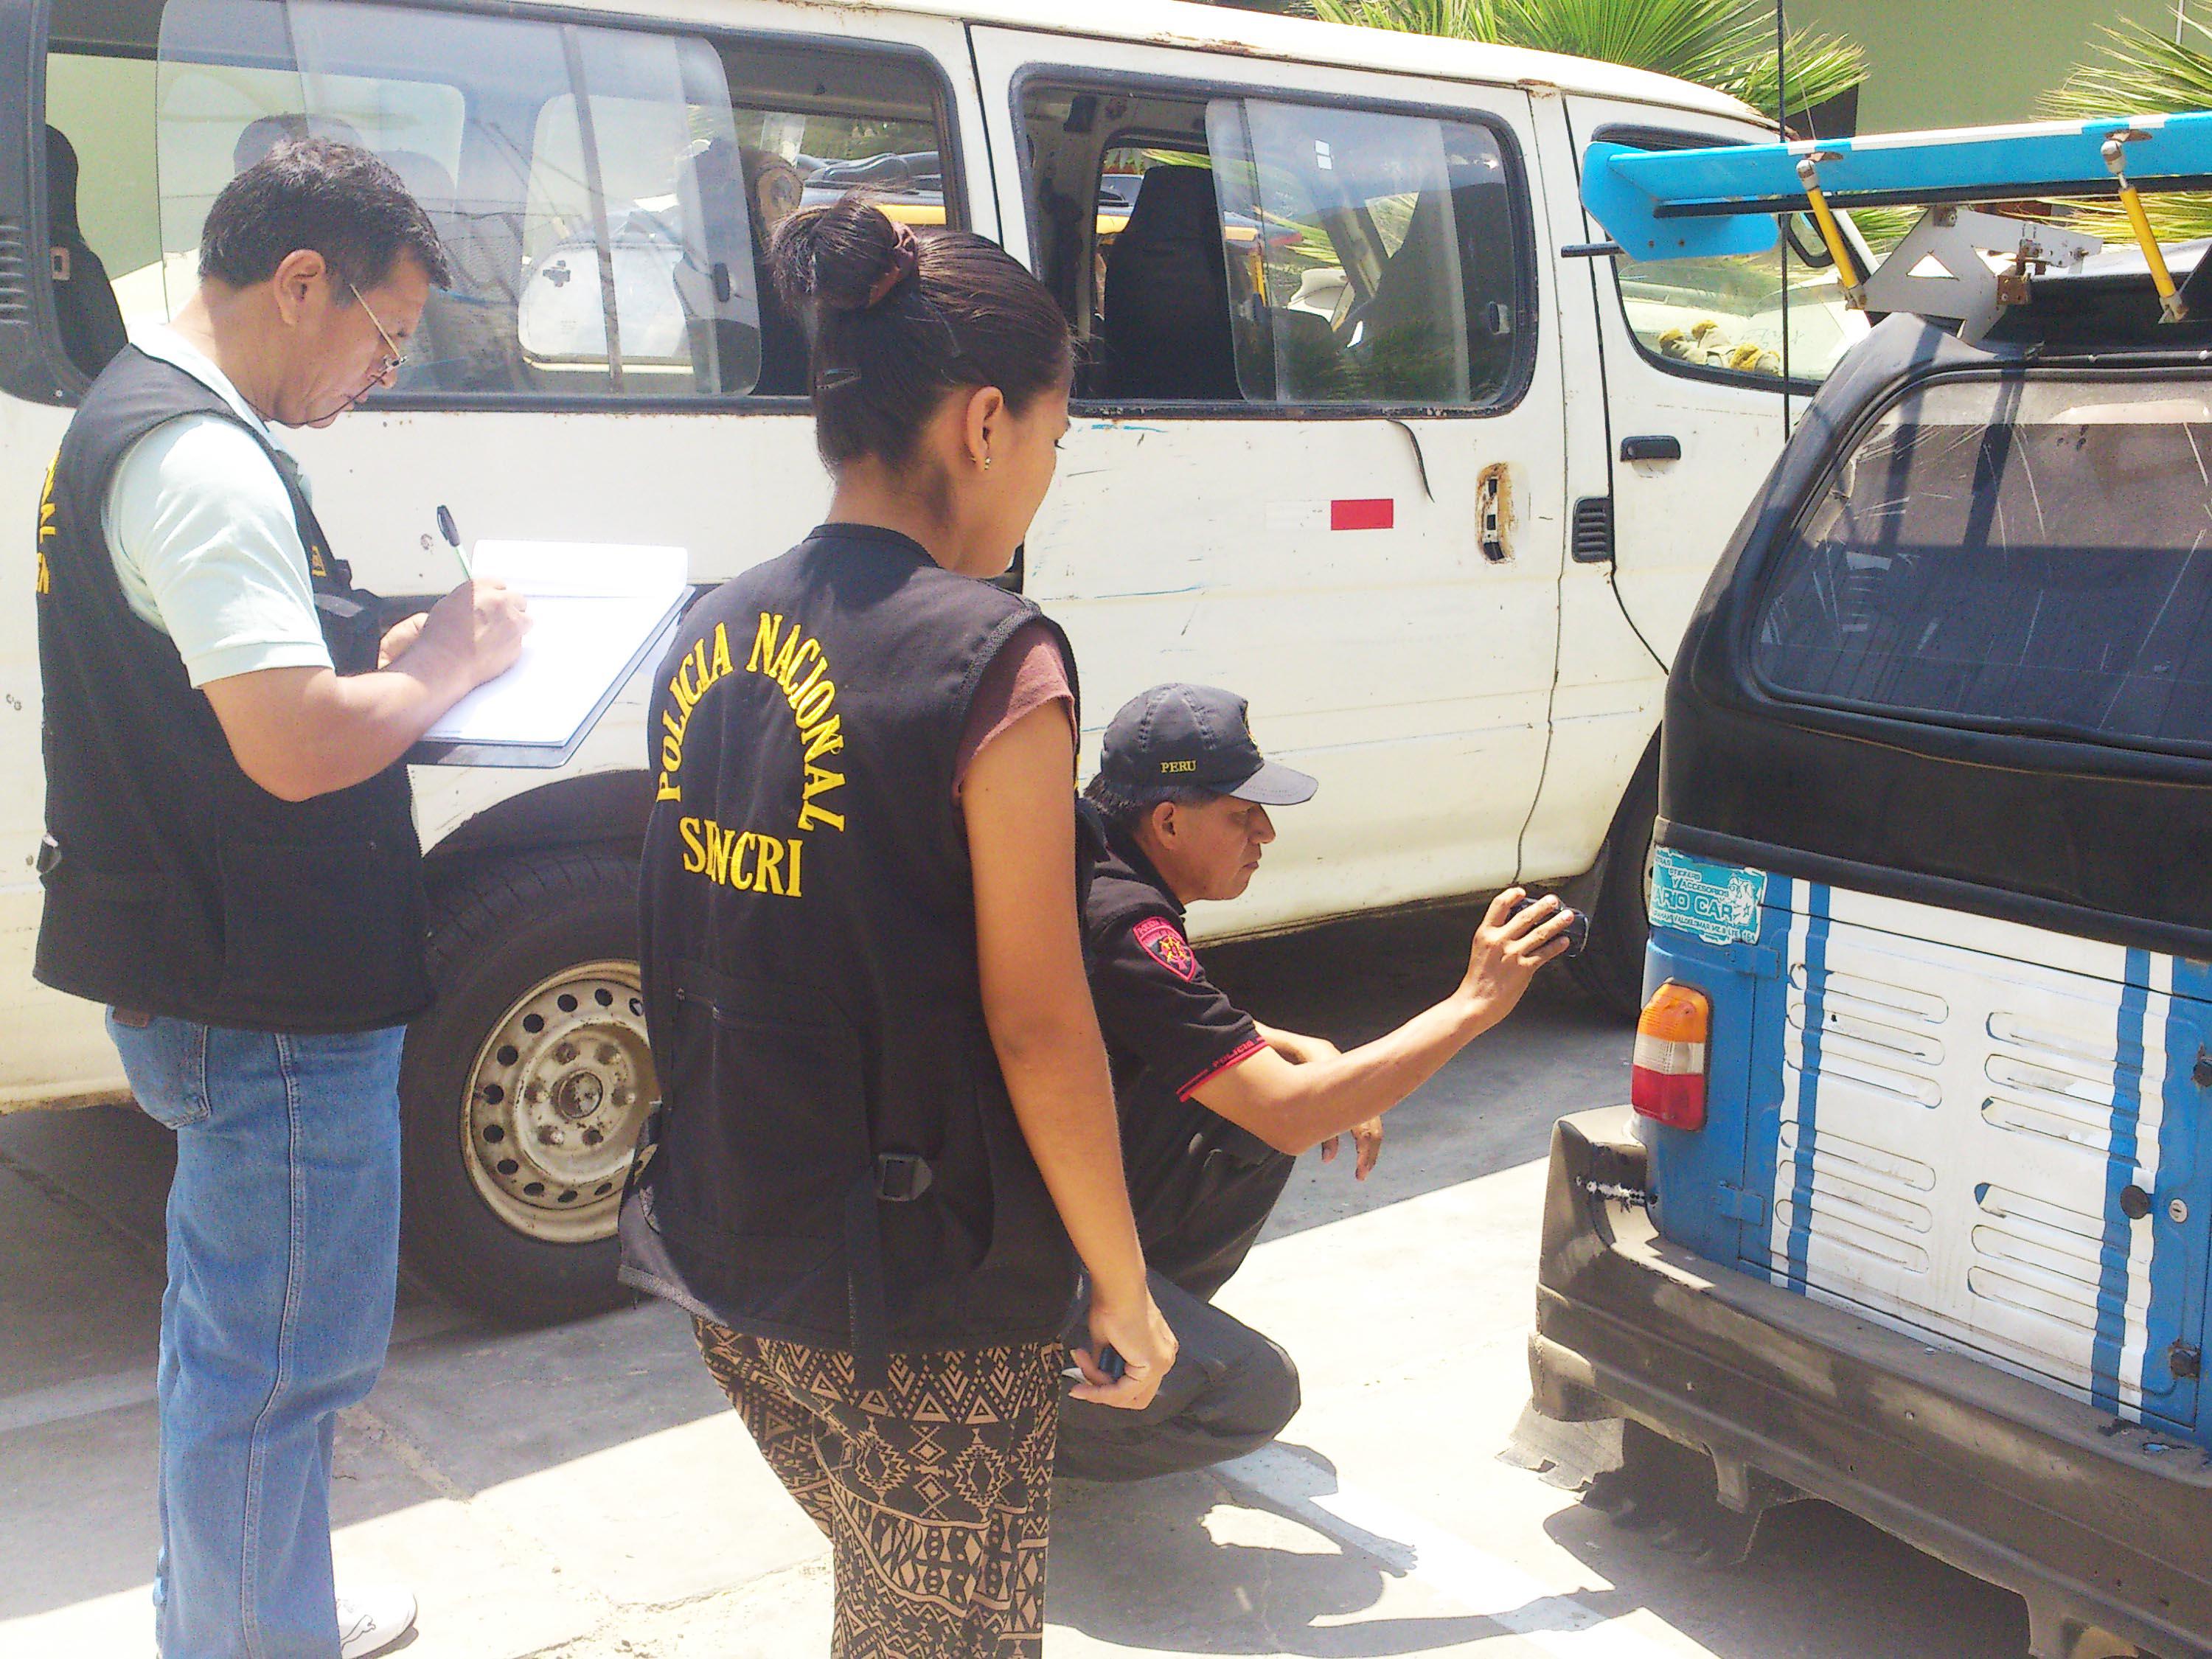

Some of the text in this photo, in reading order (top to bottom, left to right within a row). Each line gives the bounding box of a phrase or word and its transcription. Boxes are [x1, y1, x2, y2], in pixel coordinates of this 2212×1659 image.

[656, 612, 846, 832] POLICIA NACIONAL
[1160, 759, 1197, 773] PERU
[1673, 877, 1729, 897] Y ACCESORIOS
[1696, 897, 1733, 922] CAR
